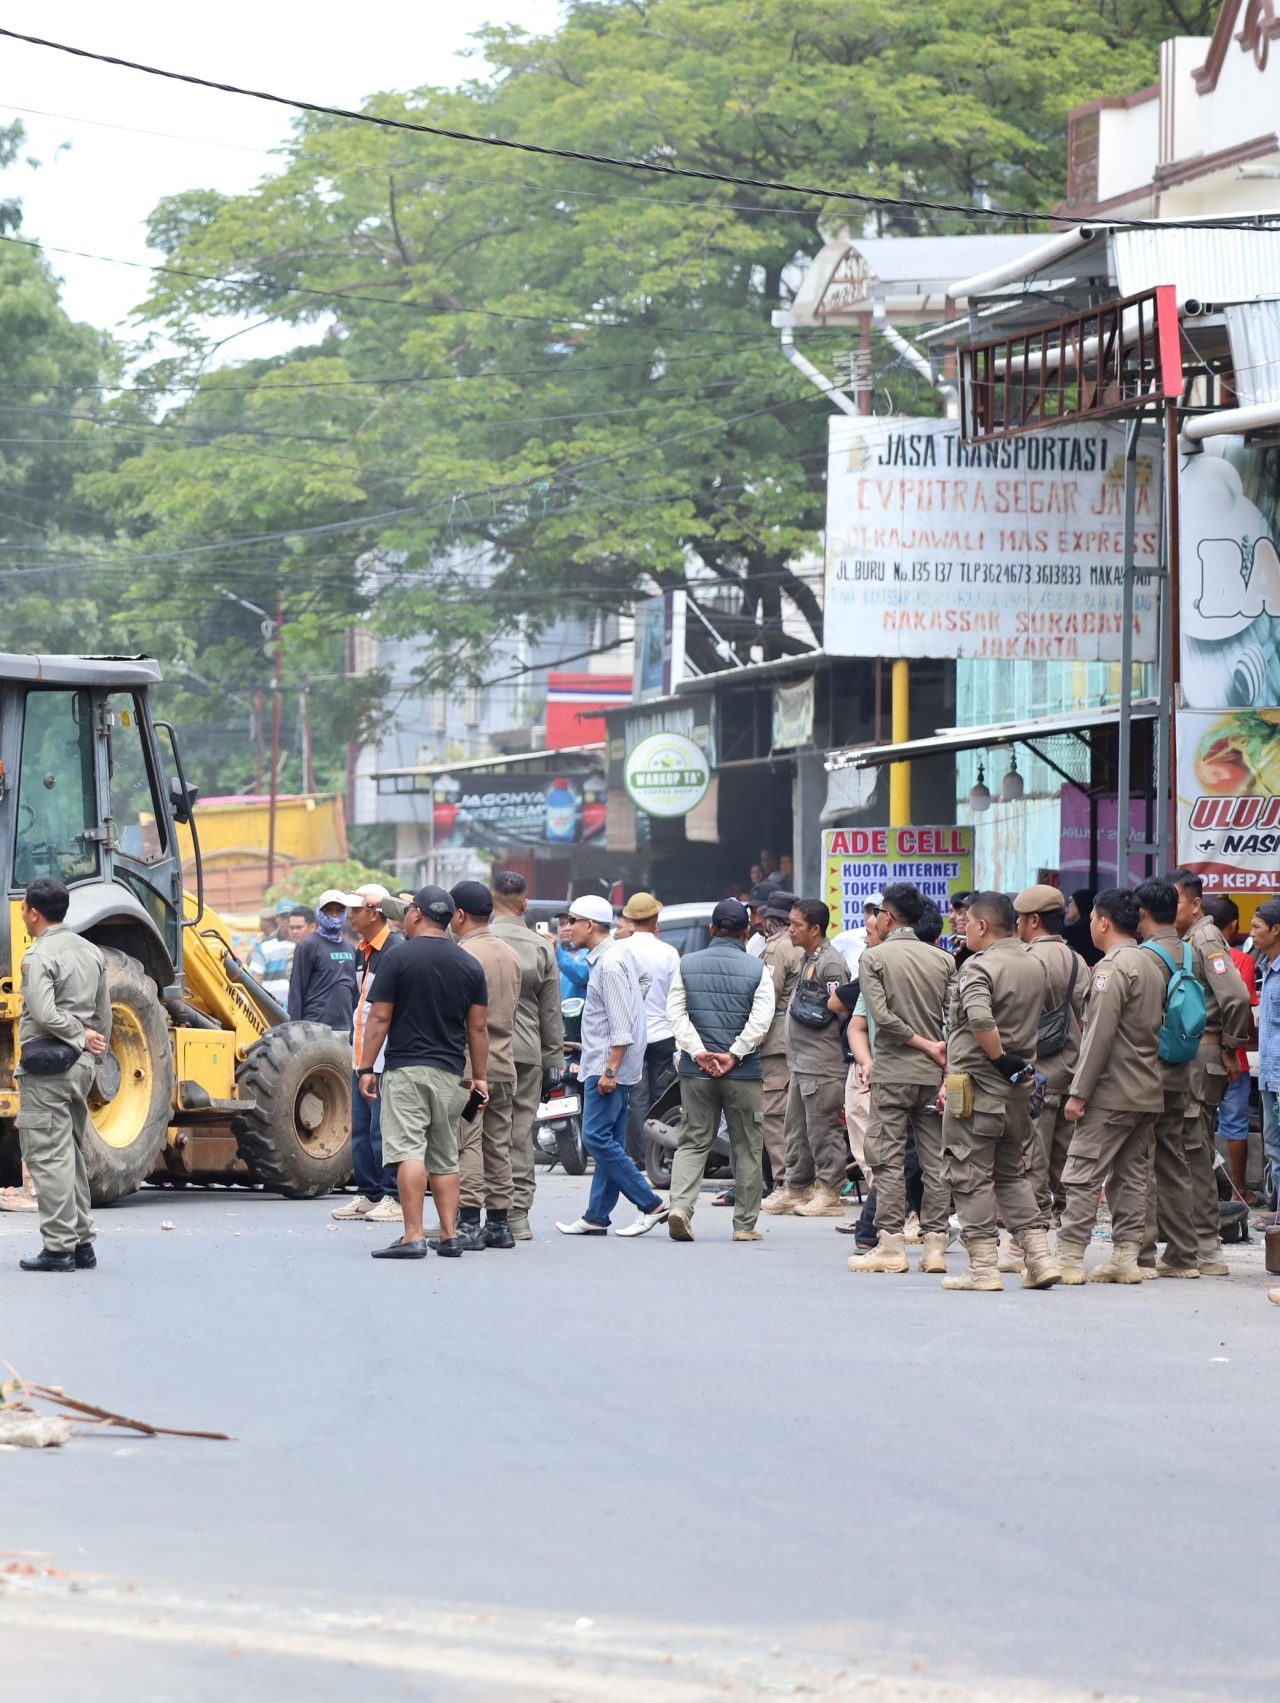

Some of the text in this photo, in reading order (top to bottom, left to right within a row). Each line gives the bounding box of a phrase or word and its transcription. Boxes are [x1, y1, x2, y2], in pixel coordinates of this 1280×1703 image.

[878, 434, 1108, 471] JASA TRANSPORTASI
[1091, 483, 1150, 515] JAA
[999, 529, 1049, 552] MAS
[935, 562, 953, 583] 137
[1090, 565, 1151, 586] MAKA
[1189, 796, 1265, 831] ULU
[831, 830, 966, 854] ADE CELL
[843, 863, 959, 877] KUOTA INTERNET
[844, 882, 887, 895] TOKEN
[226, 986, 243, 1009] NEW
